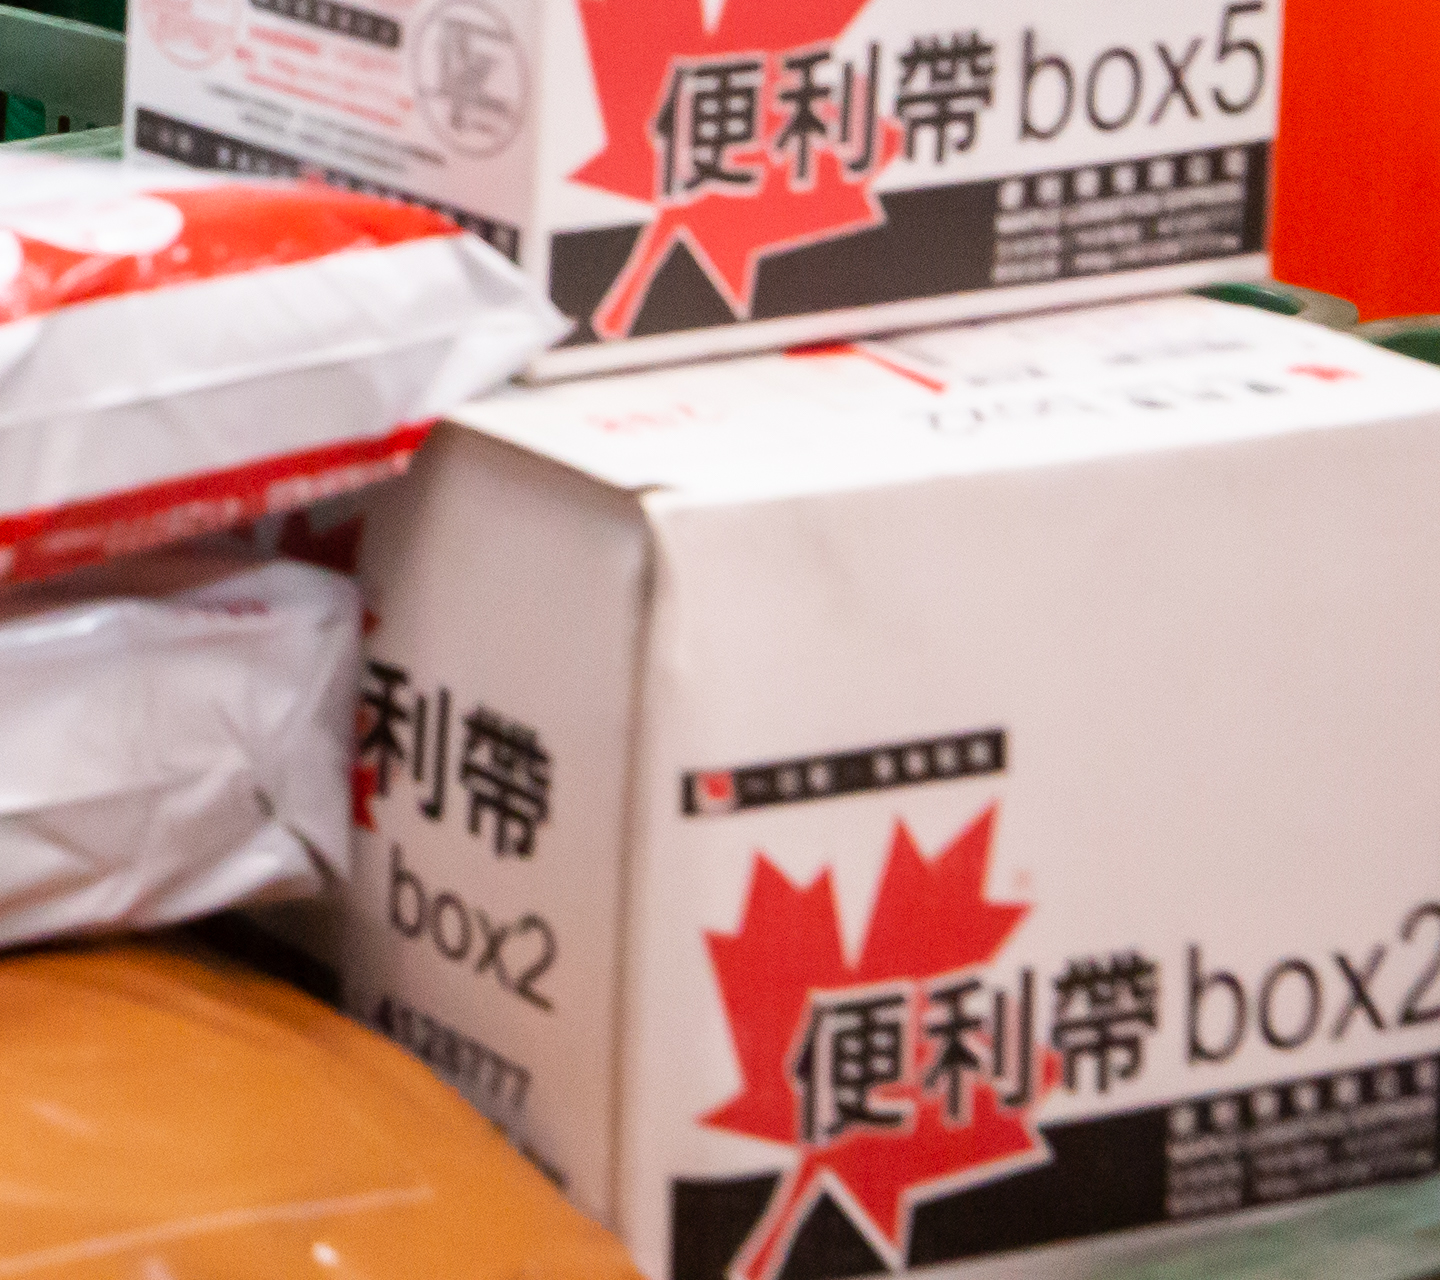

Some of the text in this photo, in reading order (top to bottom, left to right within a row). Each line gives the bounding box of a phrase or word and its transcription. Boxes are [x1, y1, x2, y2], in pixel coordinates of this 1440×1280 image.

[652, 28, 998, 200] 便利帶
[360, 660, 551, 858] 利帶
[388, 840, 555, 1014] box2
[790, 948, 1163, 1146] 便利帶
[1183, 898, 1440, 1067] box2
